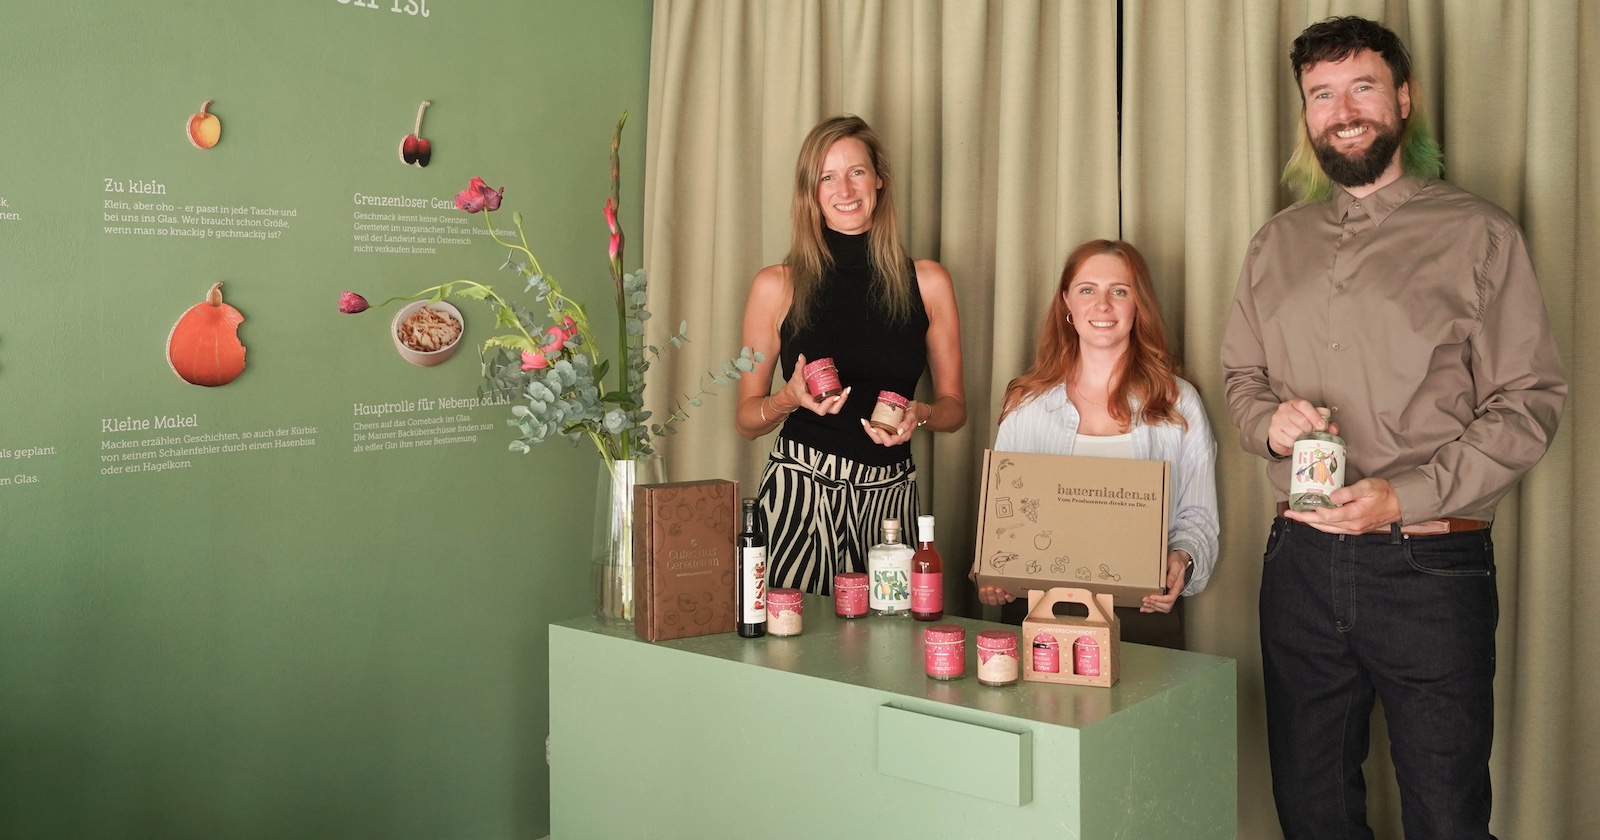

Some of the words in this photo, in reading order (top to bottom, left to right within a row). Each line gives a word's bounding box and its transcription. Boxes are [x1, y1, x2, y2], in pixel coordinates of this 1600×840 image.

[104, 178, 124, 193] Zu
[129, 180, 166, 194] klein
[104, 200, 131, 210] Klein,
[133, 202, 154, 211] aber
[156, 203, 174, 212] oho
[196, 205, 218, 214] passt
[220, 206, 229, 214] in
[230, 206, 248, 216] jede
[250, 207, 279, 216] Tasche
[354, 193, 428, 208] Grenzenloser
[431, 198, 457, 210] Genu
[104, 213, 119, 222] bei
[122, 214, 139, 222] uns
[142, 214, 156, 222] ins
[158, 215, 180, 224] Glas.
[182, 216, 200, 224] Wer
[201, 216, 234, 226] braucht
[236, 218, 262, 226] schon
[264, 219, 290, 228] Größe,
[354, 212, 396, 221] Geschmack
[398, 214, 418, 222] kennt
[419, 214, 438, 222] keine
[439, 216, 470, 224] Grenzen:
[104, 226, 132, 234] wenn
[170, 228, 205, 238] knackig
[216, 230, 266, 240] gschmackig
[268, 231, 282, 239] ist?
[354, 223, 390, 232] Gerettetet
[402, 226, 446, 234] ungarischen
[384, 234, 416, 243] Landwirt
[436, 236, 472, 244] Österreich
[375, 246, 410, 254] verkaufen
[354, 402, 414, 417] Hauptrolle
[418, 398, 436, 411] für
[102, 416, 150, 432] Kleine
[154, 414, 198, 429] Makel
[354, 422, 380, 431] Cheers
[380, 420, 392, 429] auf
[394, 418, 406, 427] das
[408, 416, 444, 426] Comeback
[446, 416, 454, 424] im
[101, 439, 139, 450] Macken
[141, 436, 181, 447] erzählen
[184, 432, 240, 444] Geschichten,
[242, 432, 252, 440] so
[254, 428, 274, 438] auch
[276, 428, 289, 437] der
[291, 426, 318, 436] Kürbis:
[354, 434, 366, 442] Die
[368, 432, 396, 440] Manner
[398, 426, 456, 438] Backüberschüsse
[458, 424, 480, 434] finden
[101, 454, 120, 462] von
[122, 450, 157, 461] seinem
[159, 444, 220, 458] Schalenfehler
[222, 442, 248, 452] durch
[249, 440, 273, 450] einen
[275, 437, 316, 448] Hasenbiss
[354, 444, 364, 452] als
[365, 443, 384, 452] edler
[385, 442, 398, 450] Gin
[400, 440, 414, 448] ihre
[415, 439, 432, 447] neue
[434, 434, 478, 446] Bestimmung.
[14, 446, 57, 460] geplant.
[101, 464, 124, 475] oder
[125, 463, 140, 474] ein
[142, 459, 193, 472] Hagelkorn.
[14, 474, 40, 484] Glas.
[1058, 484, 1157, 501] bauernladen.at
[1072, 498, 1108, 506] Produzenten
[668, 550, 696, 560] Gutes
[699, 548, 717, 557] aus
[1044, 627, 1096, 636] UNVERSCHWENDET
